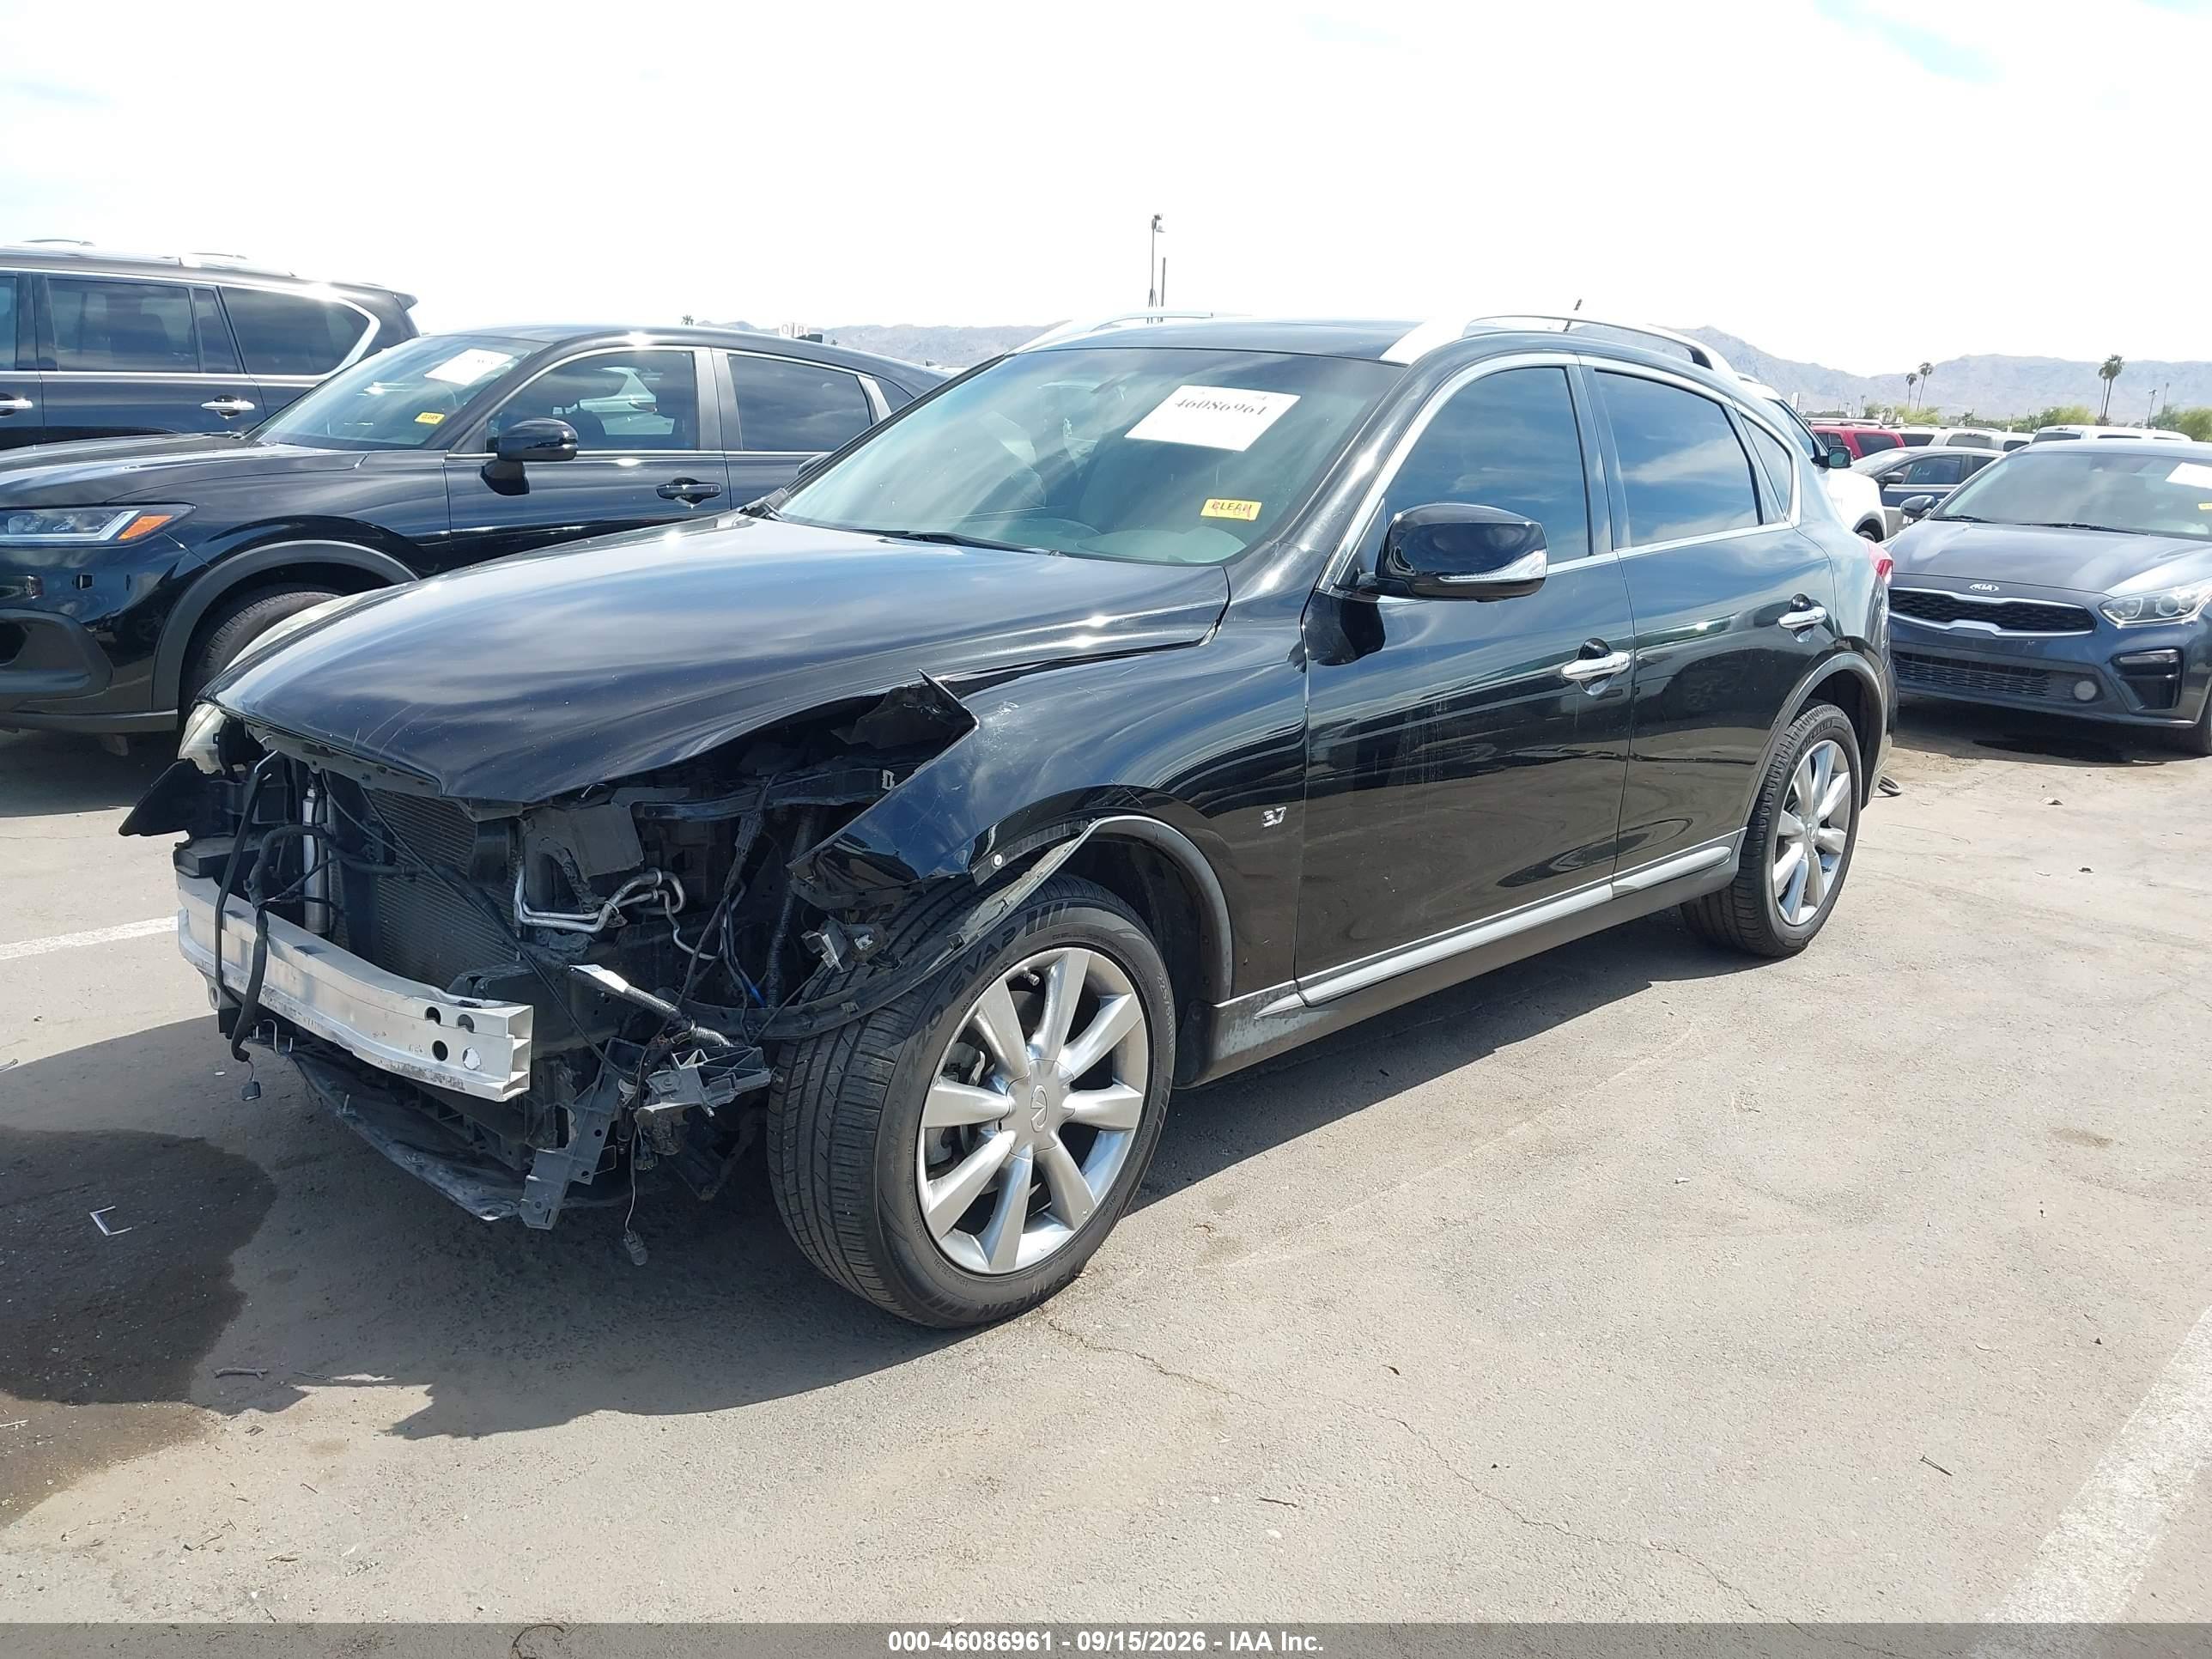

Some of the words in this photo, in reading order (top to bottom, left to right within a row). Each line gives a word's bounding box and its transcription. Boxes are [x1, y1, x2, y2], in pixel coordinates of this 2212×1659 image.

[1176, 398, 1267, 415] 46086961
[1212, 502, 1252, 512] CLEAN
[1972, 583, 1995, 592] KIA
